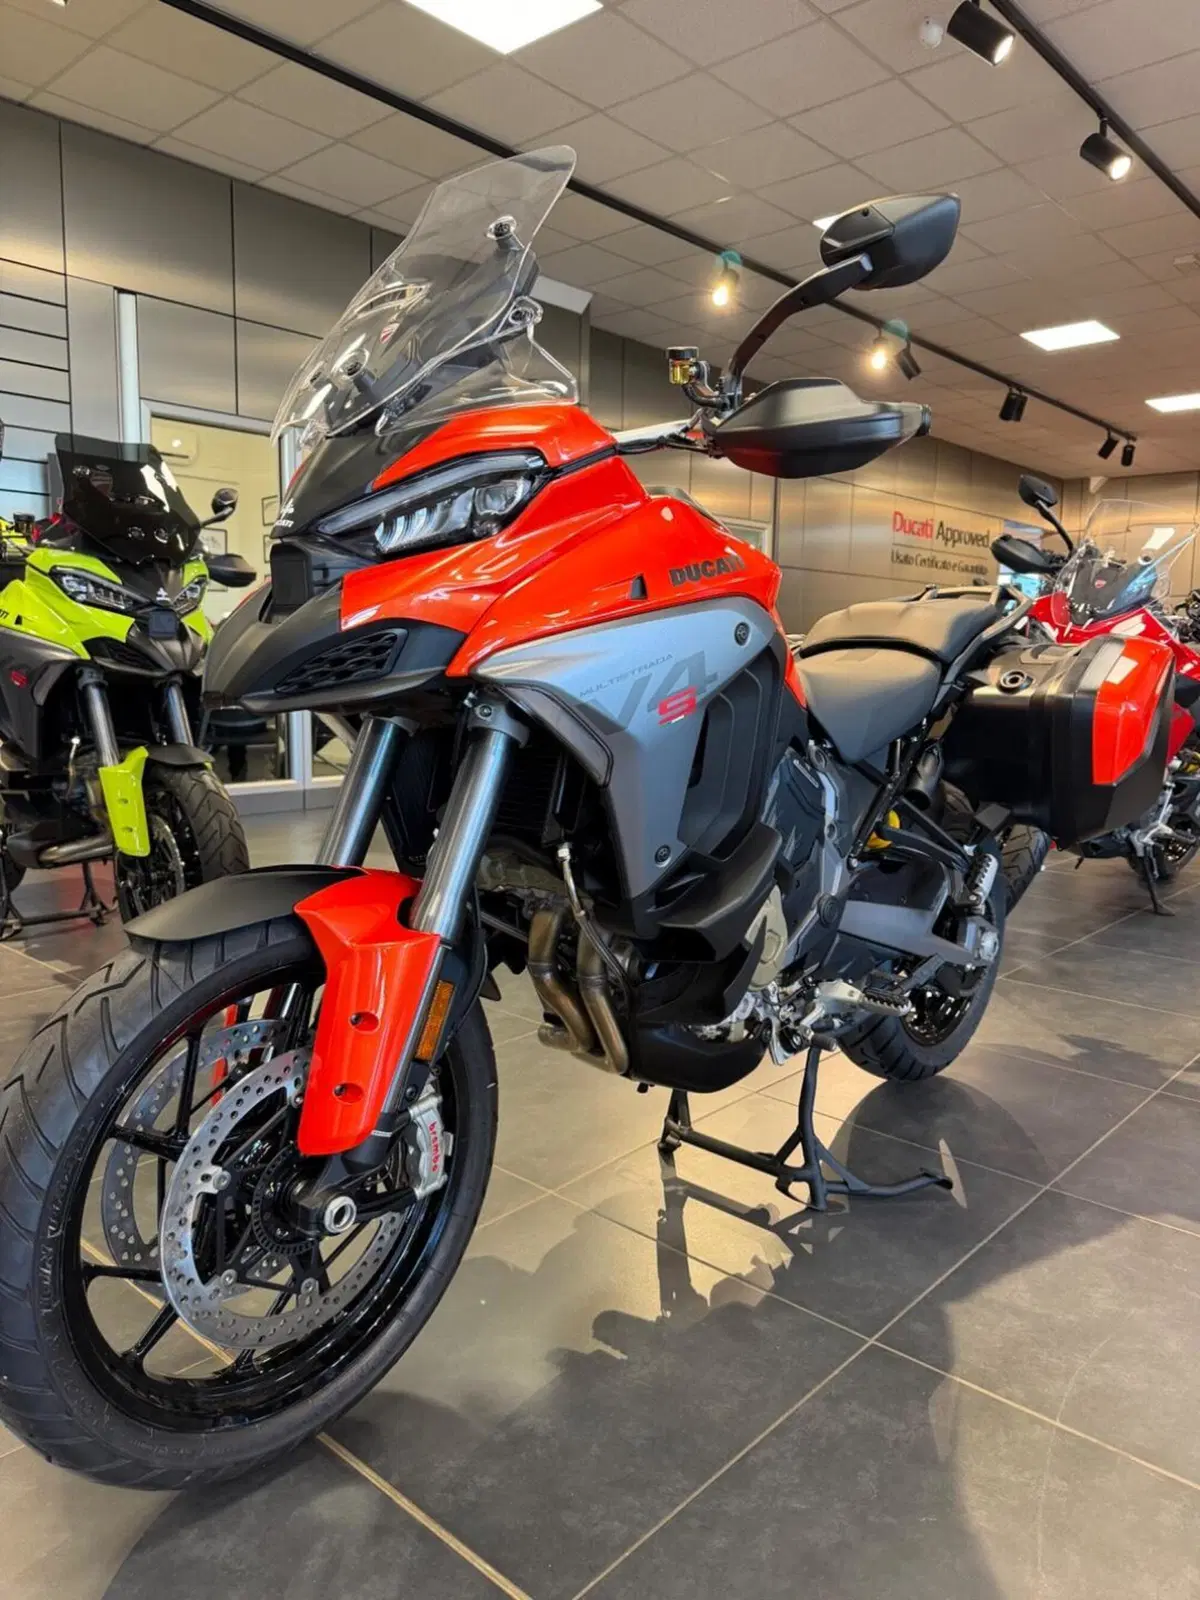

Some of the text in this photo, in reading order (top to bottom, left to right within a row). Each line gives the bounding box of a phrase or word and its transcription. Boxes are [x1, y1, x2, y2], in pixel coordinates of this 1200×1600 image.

[892, 510, 990, 548] Ducati Approved
[890, 548, 914, 565] Usato
[574, 650, 718, 736] V4
[579, 652, 674, 697] MULTISTRADA
[428, 1121, 440, 1173] brembo
